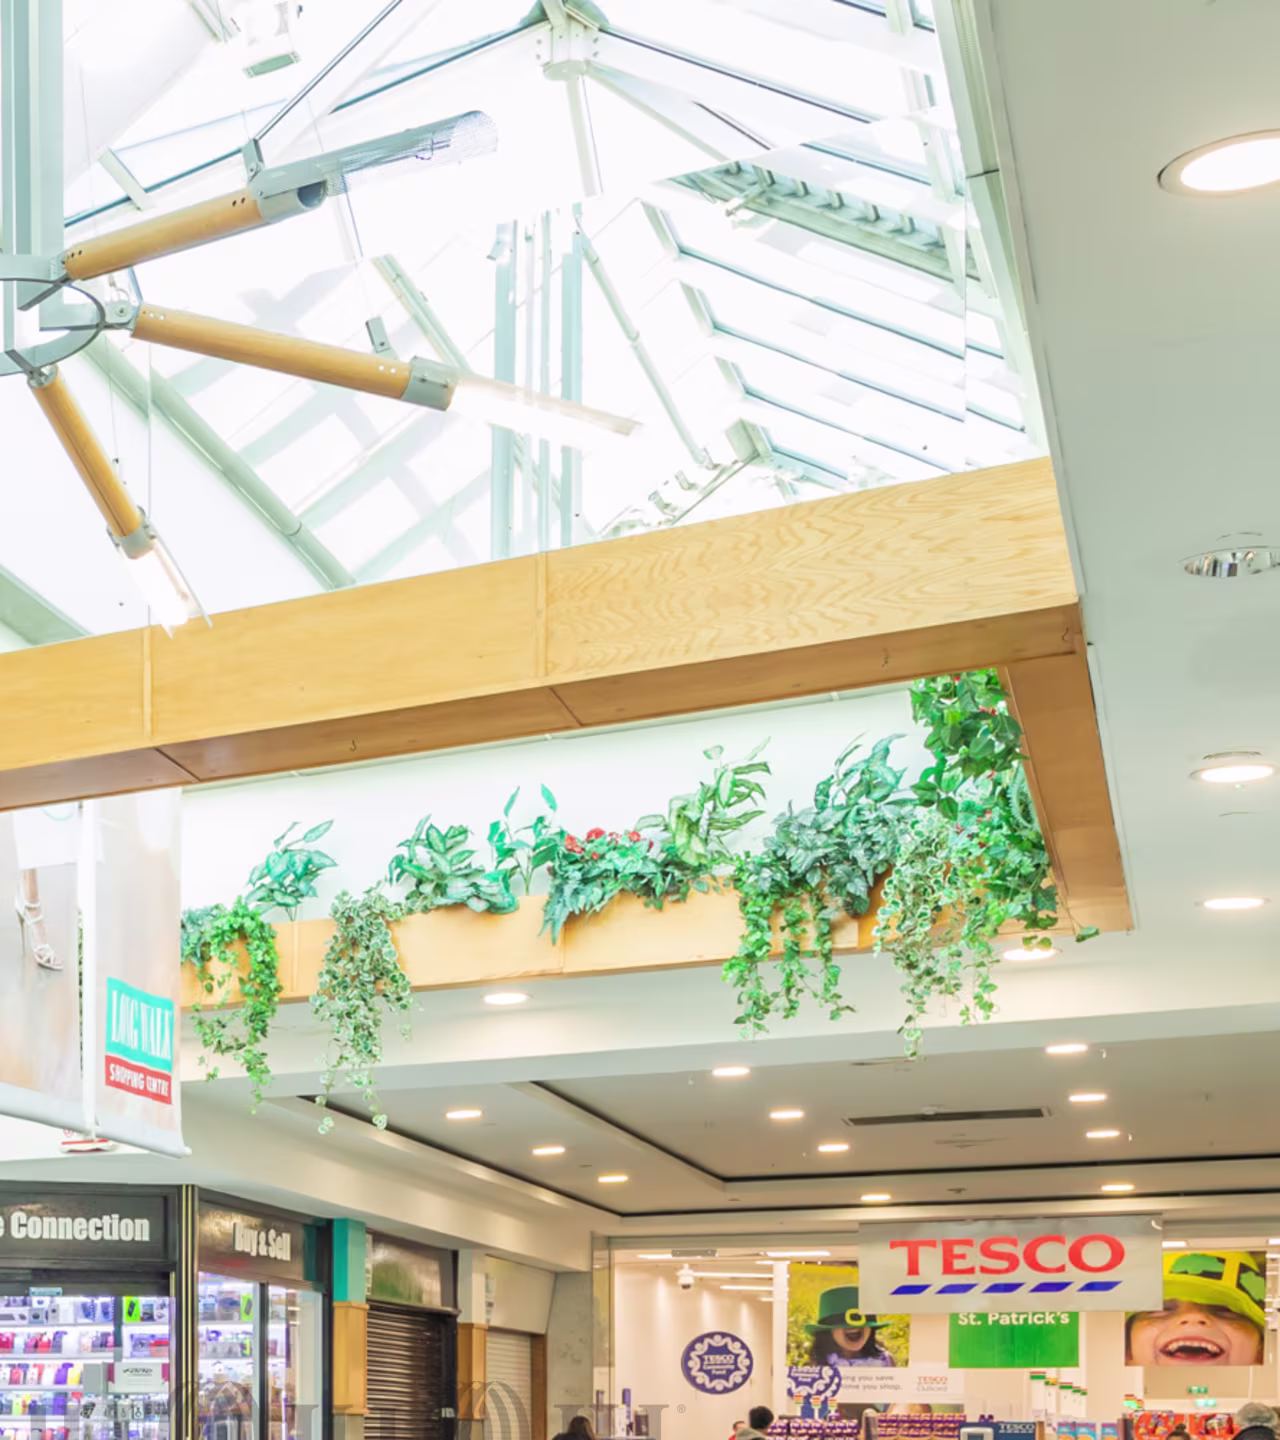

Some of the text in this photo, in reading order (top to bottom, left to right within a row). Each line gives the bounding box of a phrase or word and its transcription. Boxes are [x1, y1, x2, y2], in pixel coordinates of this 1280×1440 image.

[109, 1063, 145, 1091] SHOPPING
[10, 1212, 150, 1242] Connection
[234, 1222, 257, 1257] Buy
[268, 1228, 291, 1261] Sell
[889, 1233, 1125, 1276] TESCO
[957, 1311, 1070, 1325] St. Patrick's
[999, 1423, 1035, 1431] TESCO
